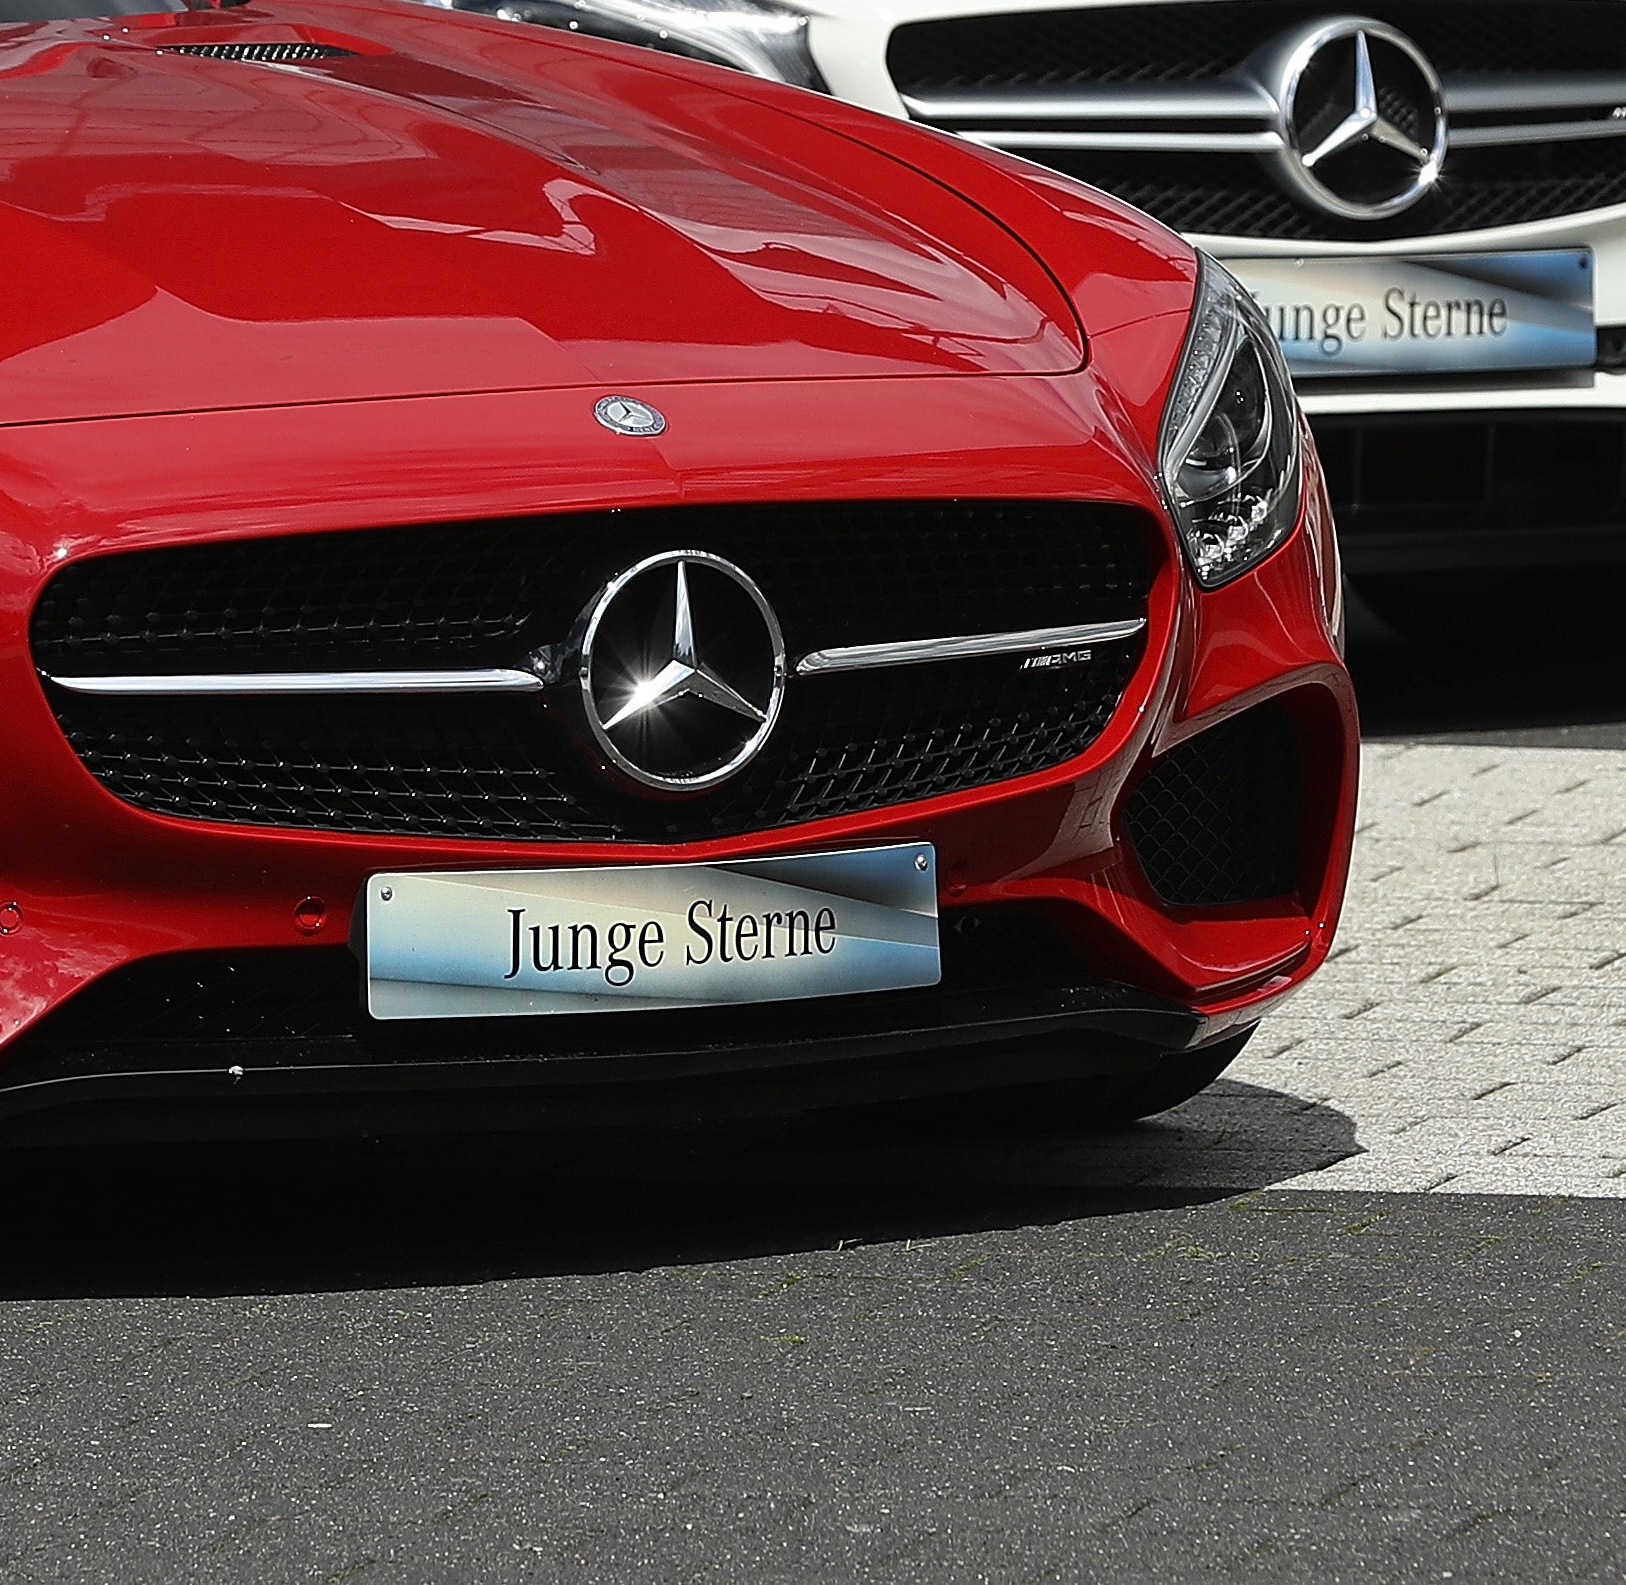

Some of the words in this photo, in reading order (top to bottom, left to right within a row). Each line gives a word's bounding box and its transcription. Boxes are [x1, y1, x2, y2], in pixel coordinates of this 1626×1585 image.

[1252, 290, 1367, 356] unge
[1382, 286, 1508, 340] Sterne
[504, 908, 666, 987] Junge
[685, 900, 837, 966] Sterne
